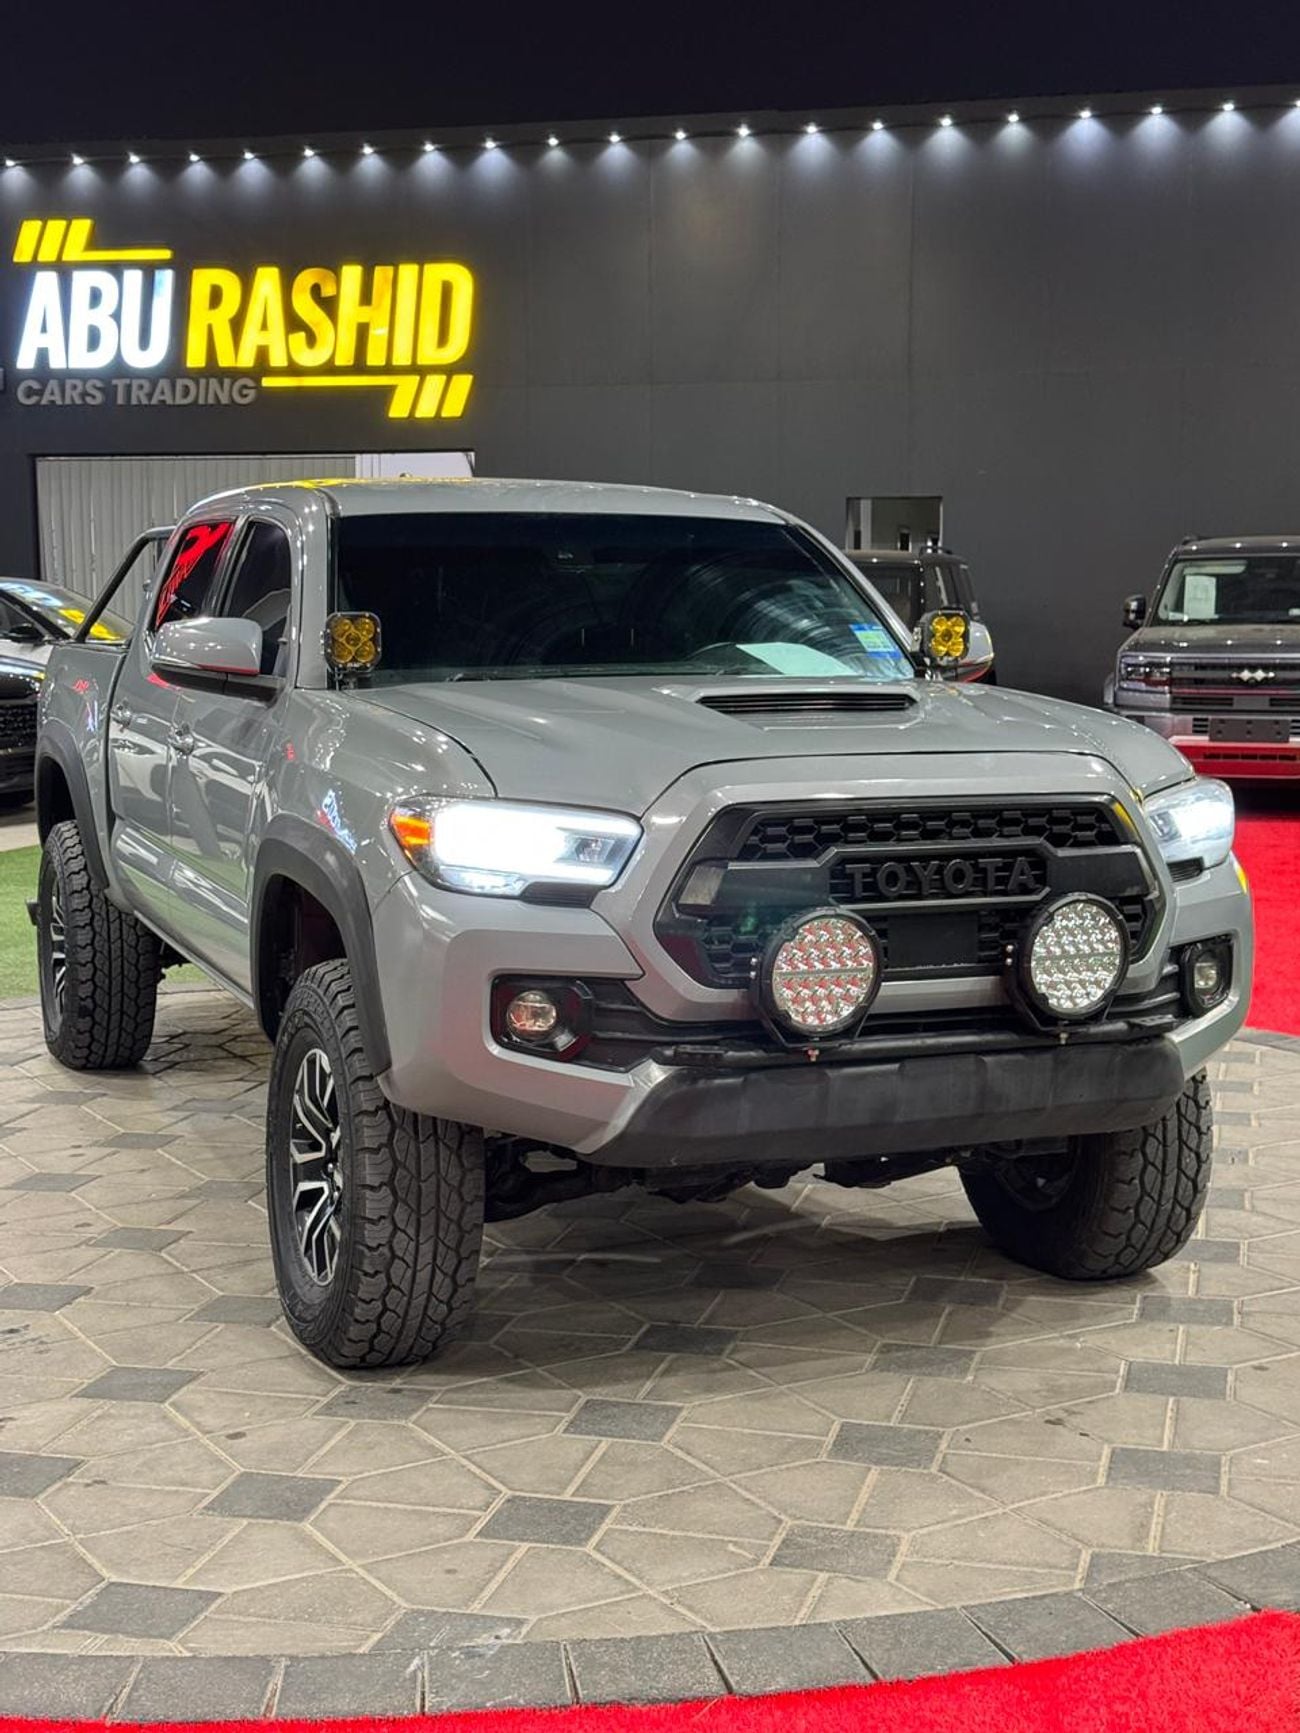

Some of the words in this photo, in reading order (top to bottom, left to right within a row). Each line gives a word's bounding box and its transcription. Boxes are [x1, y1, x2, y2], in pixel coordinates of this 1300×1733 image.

[16, 269, 173, 369] ABU
[186, 263, 474, 368] RASHID
[16, 379, 102, 406] CARS
[112, 377, 257, 405] TRADING
[845, 856, 1037, 898] TOYOTA
